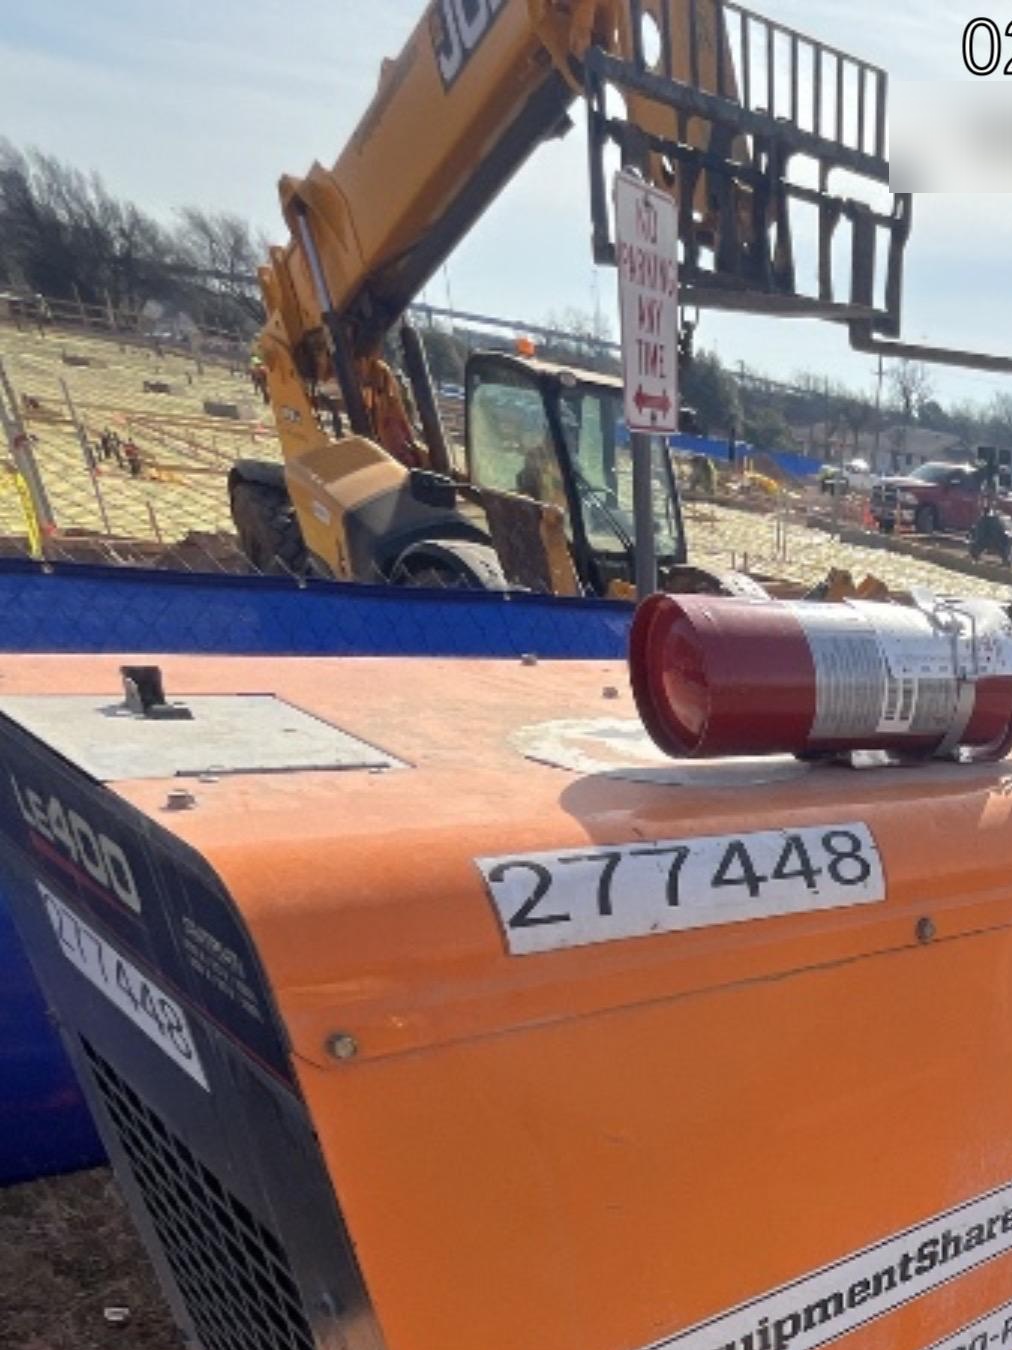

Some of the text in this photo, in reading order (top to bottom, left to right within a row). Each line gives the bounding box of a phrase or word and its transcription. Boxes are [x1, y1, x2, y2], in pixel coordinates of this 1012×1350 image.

[440, 0, 501, 82] JC
[635, 197, 658, 244] NO
[619, 240, 676, 297] PARKING
[637, 294, 663, 336] ANY
[636, 338, 666, 379] TIME
[489, 829, 871, 928] 277448
[42, 892, 193, 1061] 277448
